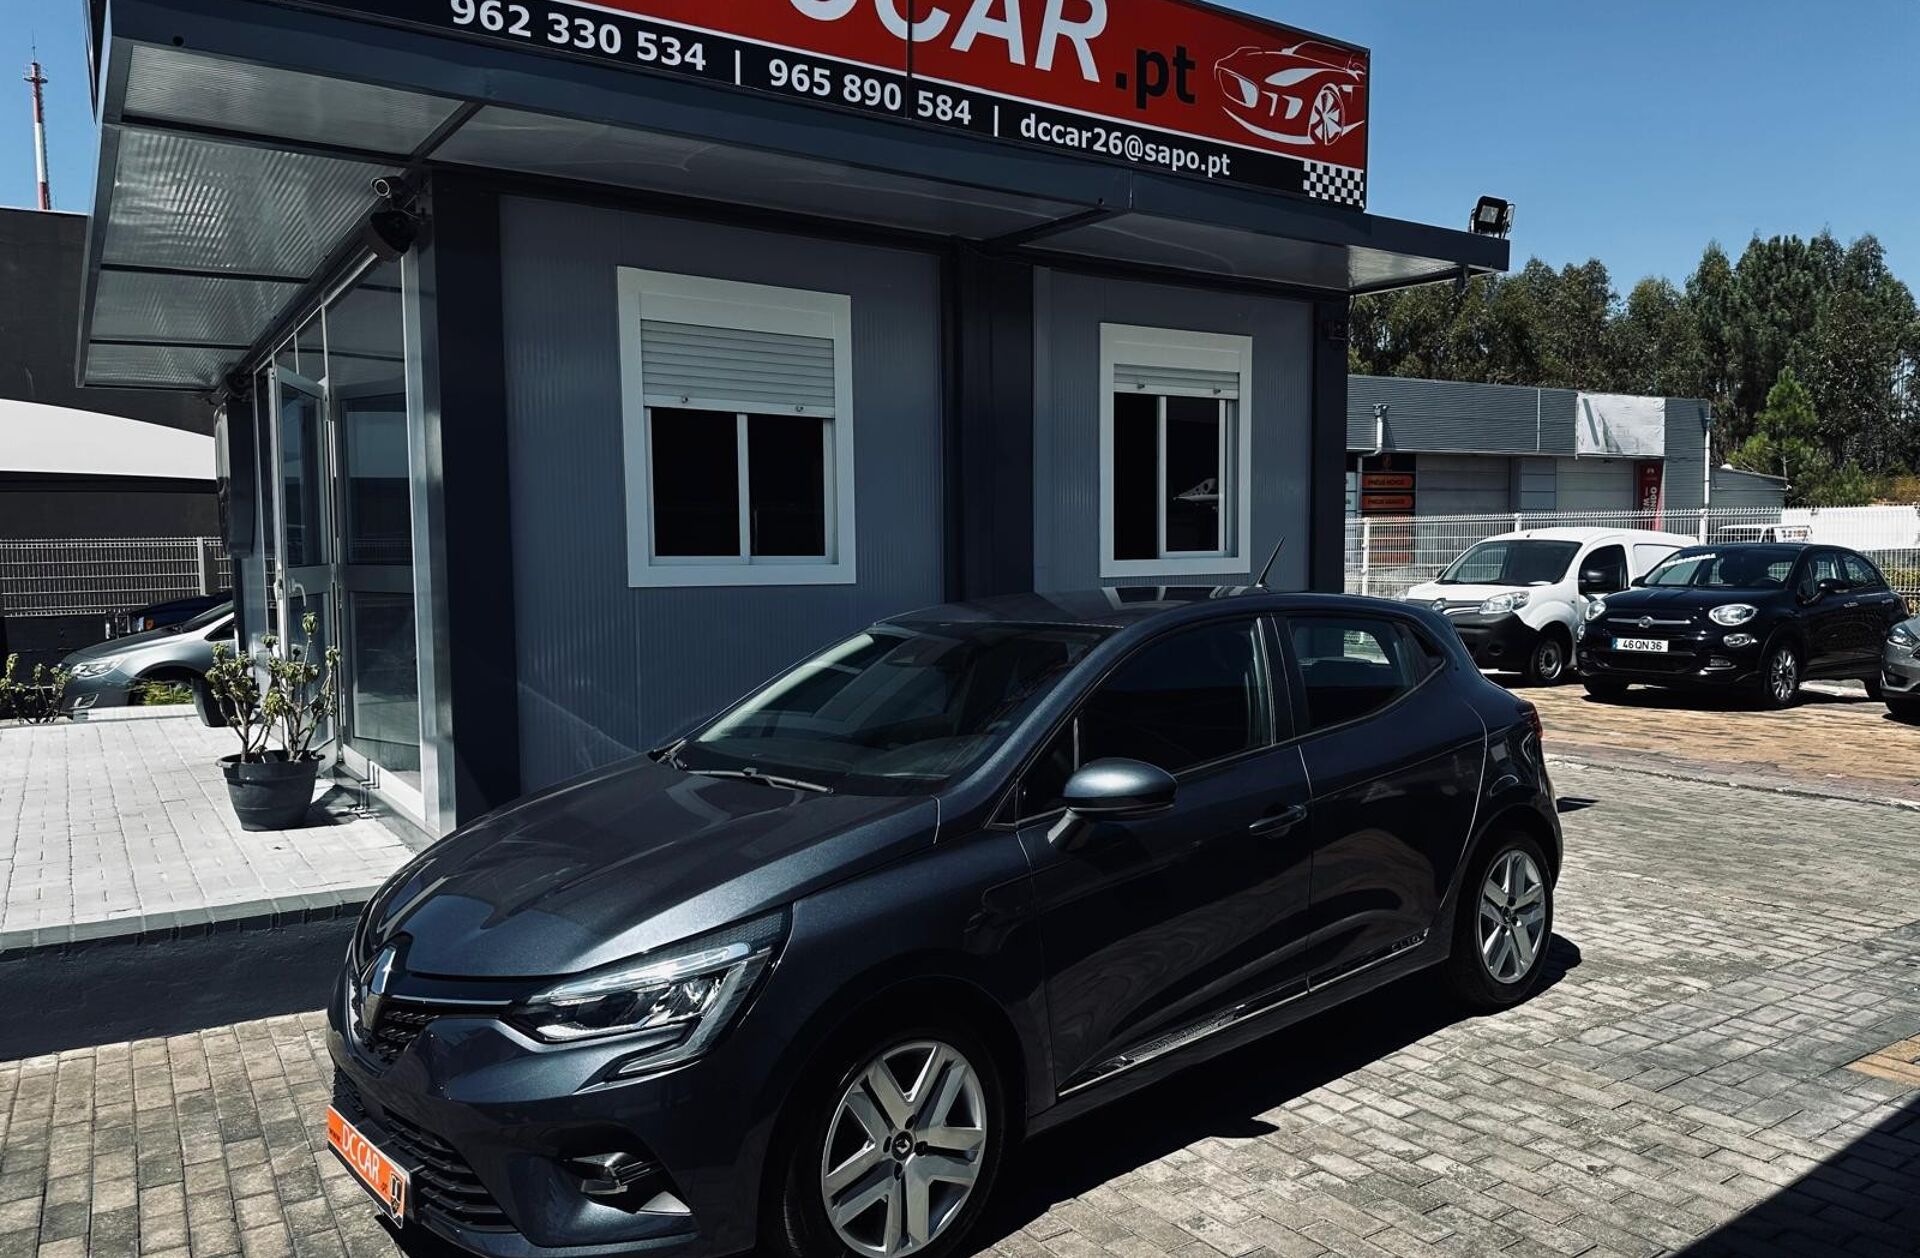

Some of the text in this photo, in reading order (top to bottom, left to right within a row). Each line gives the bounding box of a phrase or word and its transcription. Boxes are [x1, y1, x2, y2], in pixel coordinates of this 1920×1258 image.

[450, 0, 532, 38] 962
[547, 12, 622, 54] 330
[636, 31, 706, 71] 534
[769, 59, 831, 96] 965
[843, 74, 902, 111] 890
[917, 90, 972, 125] 584
[1020, 112, 1231, 177] dccar26@sapo.pt
